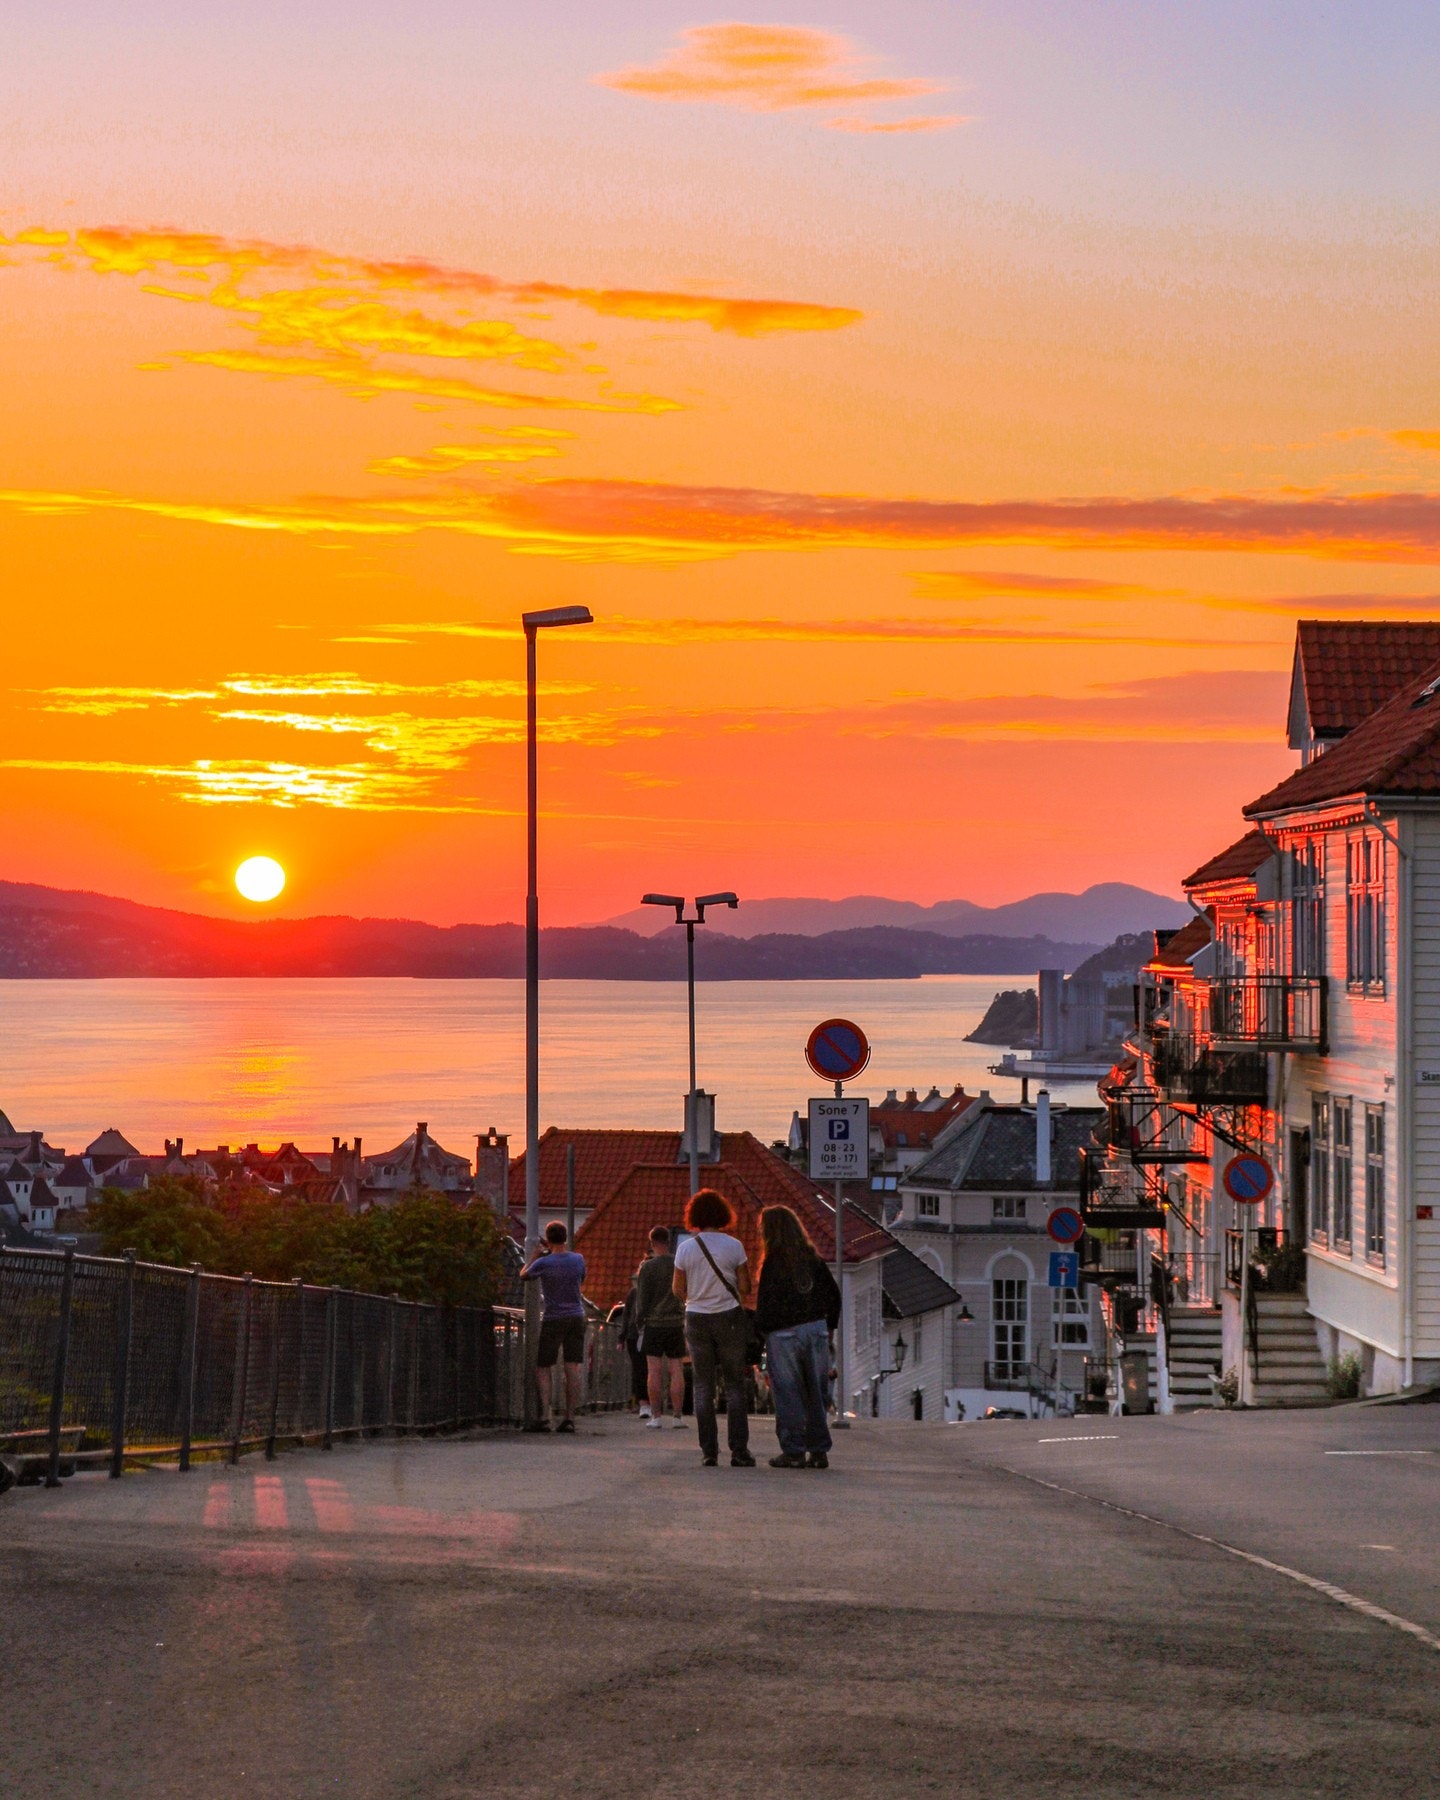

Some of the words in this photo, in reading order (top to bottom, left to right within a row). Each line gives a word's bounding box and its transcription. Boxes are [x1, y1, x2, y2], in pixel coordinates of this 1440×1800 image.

[818, 1104, 847, 1115] Sone
[853, 1104, 859, 1115] 7
[833, 1121, 846, 1138] P
